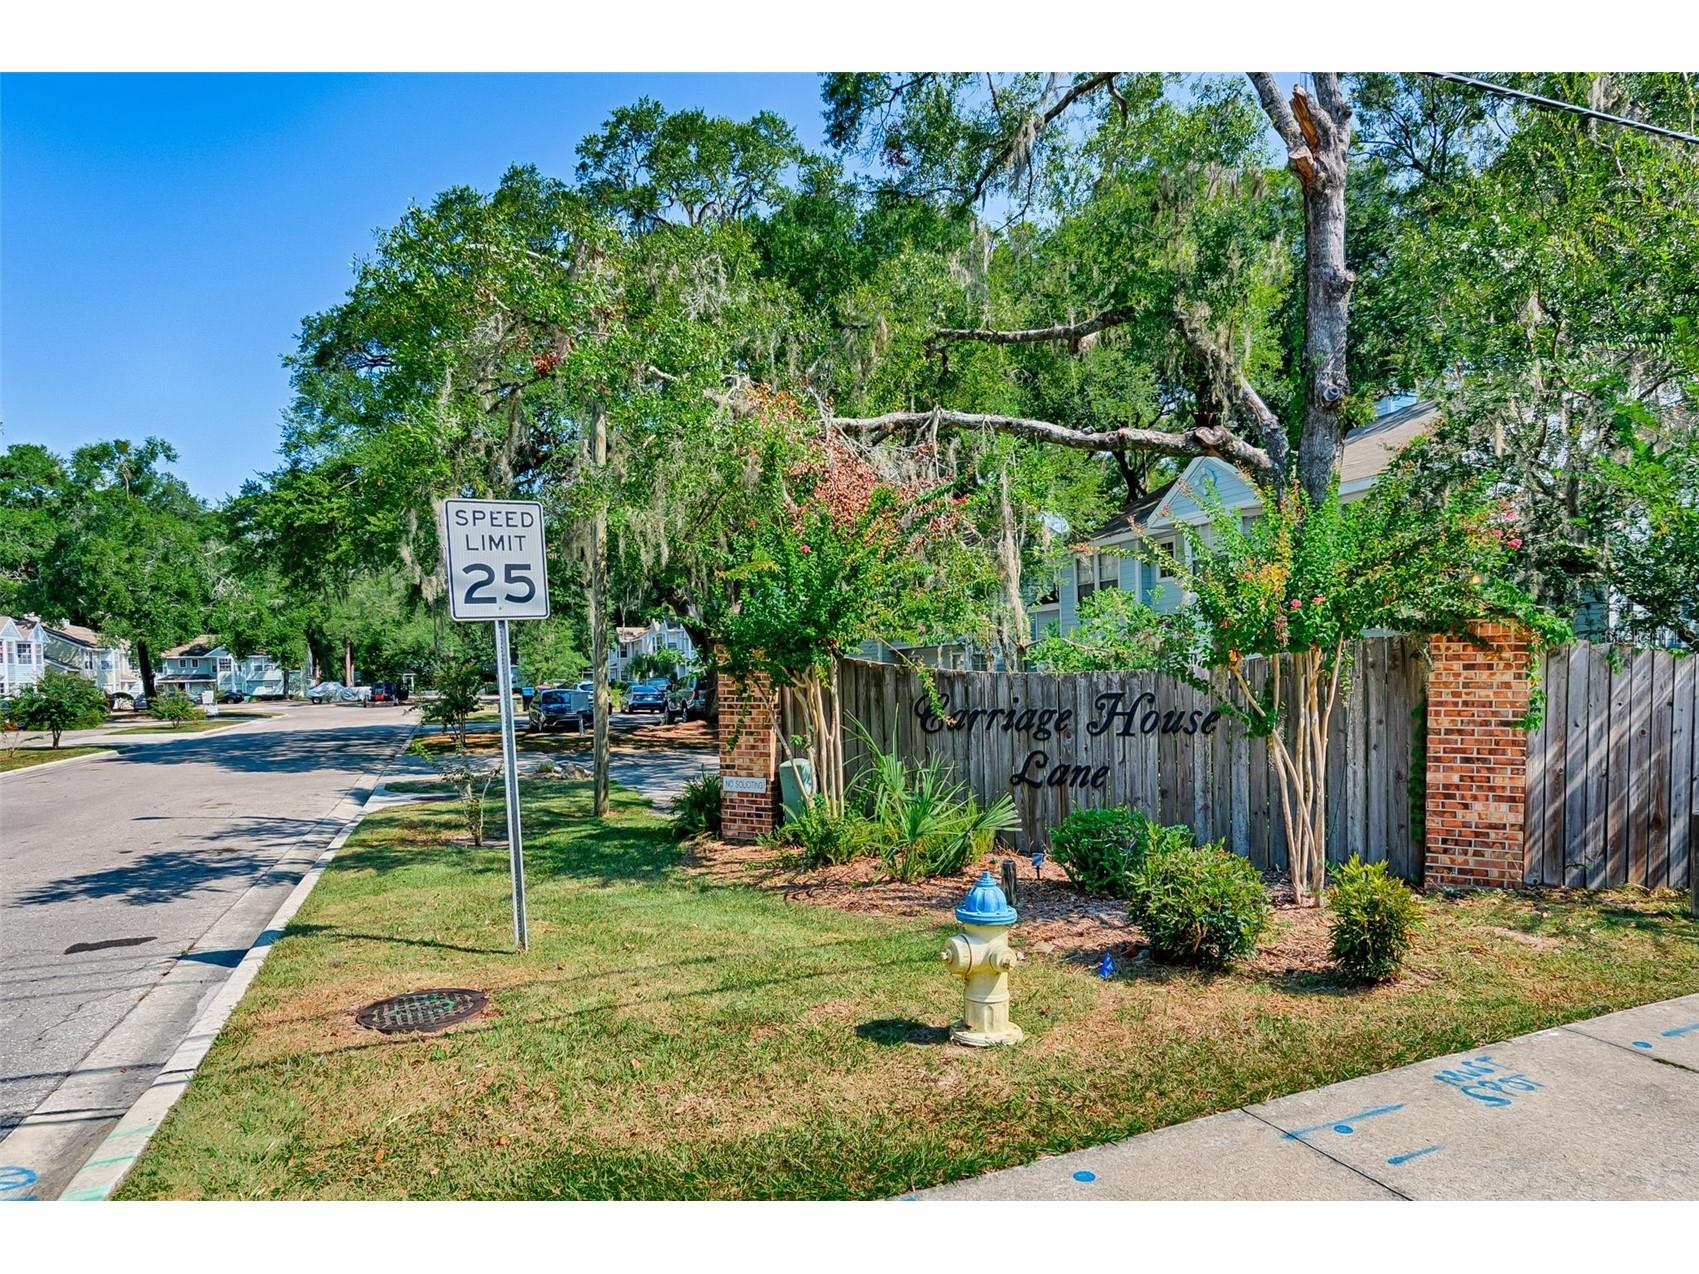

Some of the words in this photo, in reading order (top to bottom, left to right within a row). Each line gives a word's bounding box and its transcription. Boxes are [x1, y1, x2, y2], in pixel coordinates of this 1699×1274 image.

[455, 509, 534, 528] SPEED
[465, 534, 526, 551] LIMIT
[462, 563, 536, 604] 25
[914, 693, 1072, 741] Carriage
[1086, 692, 1221, 737] House
[725, 779, 734, 788] NO
[1010, 750, 1110, 789] Lane
